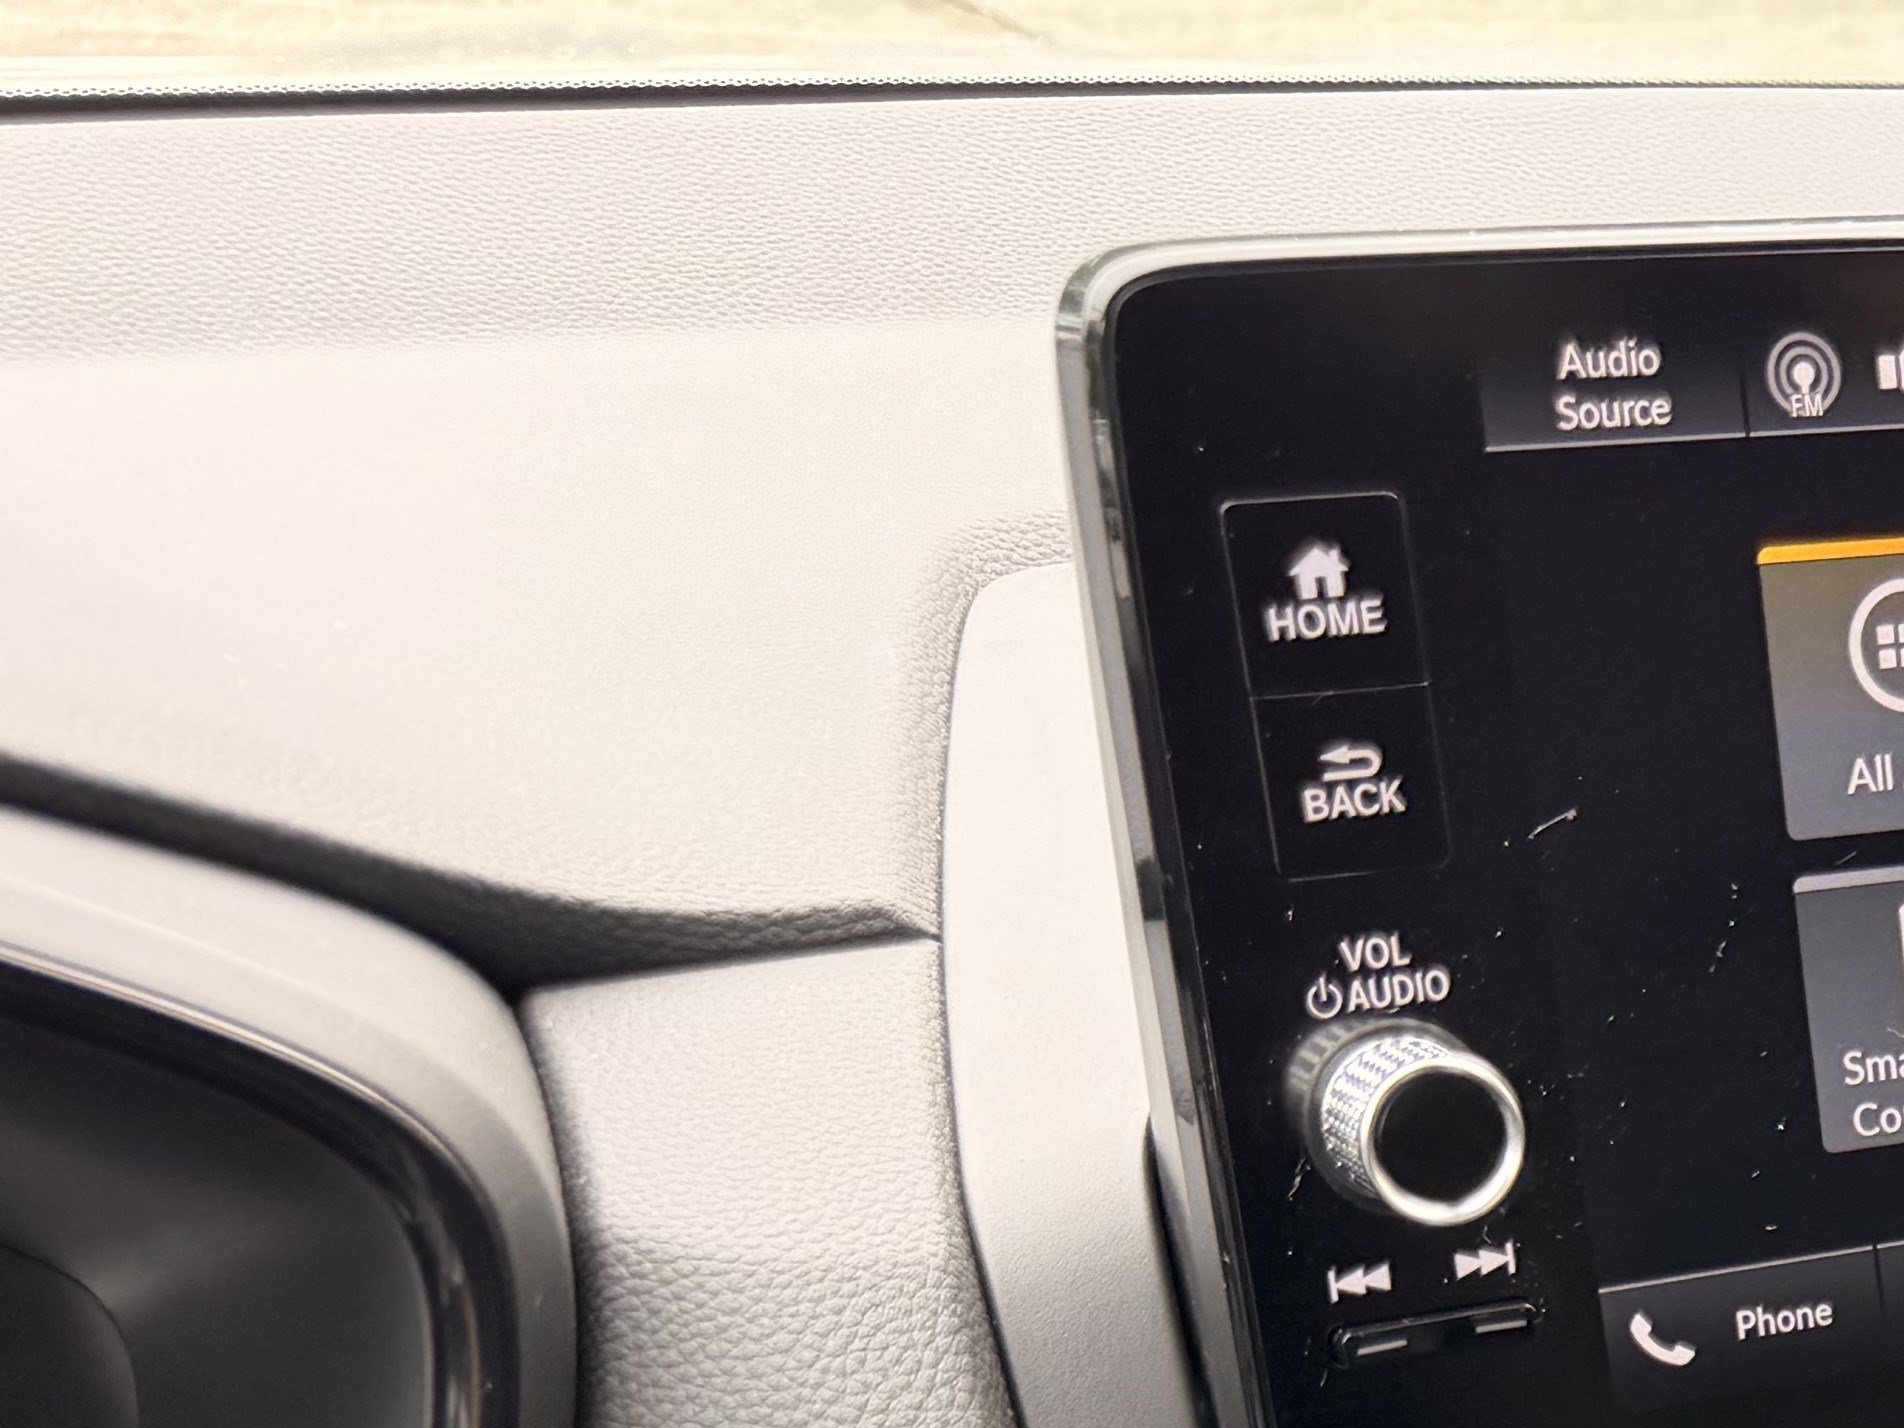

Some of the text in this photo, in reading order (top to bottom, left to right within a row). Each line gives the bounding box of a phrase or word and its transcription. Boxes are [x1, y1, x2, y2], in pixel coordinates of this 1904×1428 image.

[1557, 338, 1661, 380] Audio
[1555, 392, 1673, 431] Source
[1789, 394, 1825, 419] FM
[1264, 598, 1388, 643] HOME
[1847, 755, 1893, 795] All
[1301, 777, 1406, 823] BACK
[1339, 934, 1411, 972] VOL
[1347, 966, 1451, 1011] AUDIO
[1736, 1301, 1833, 1340] Phone
